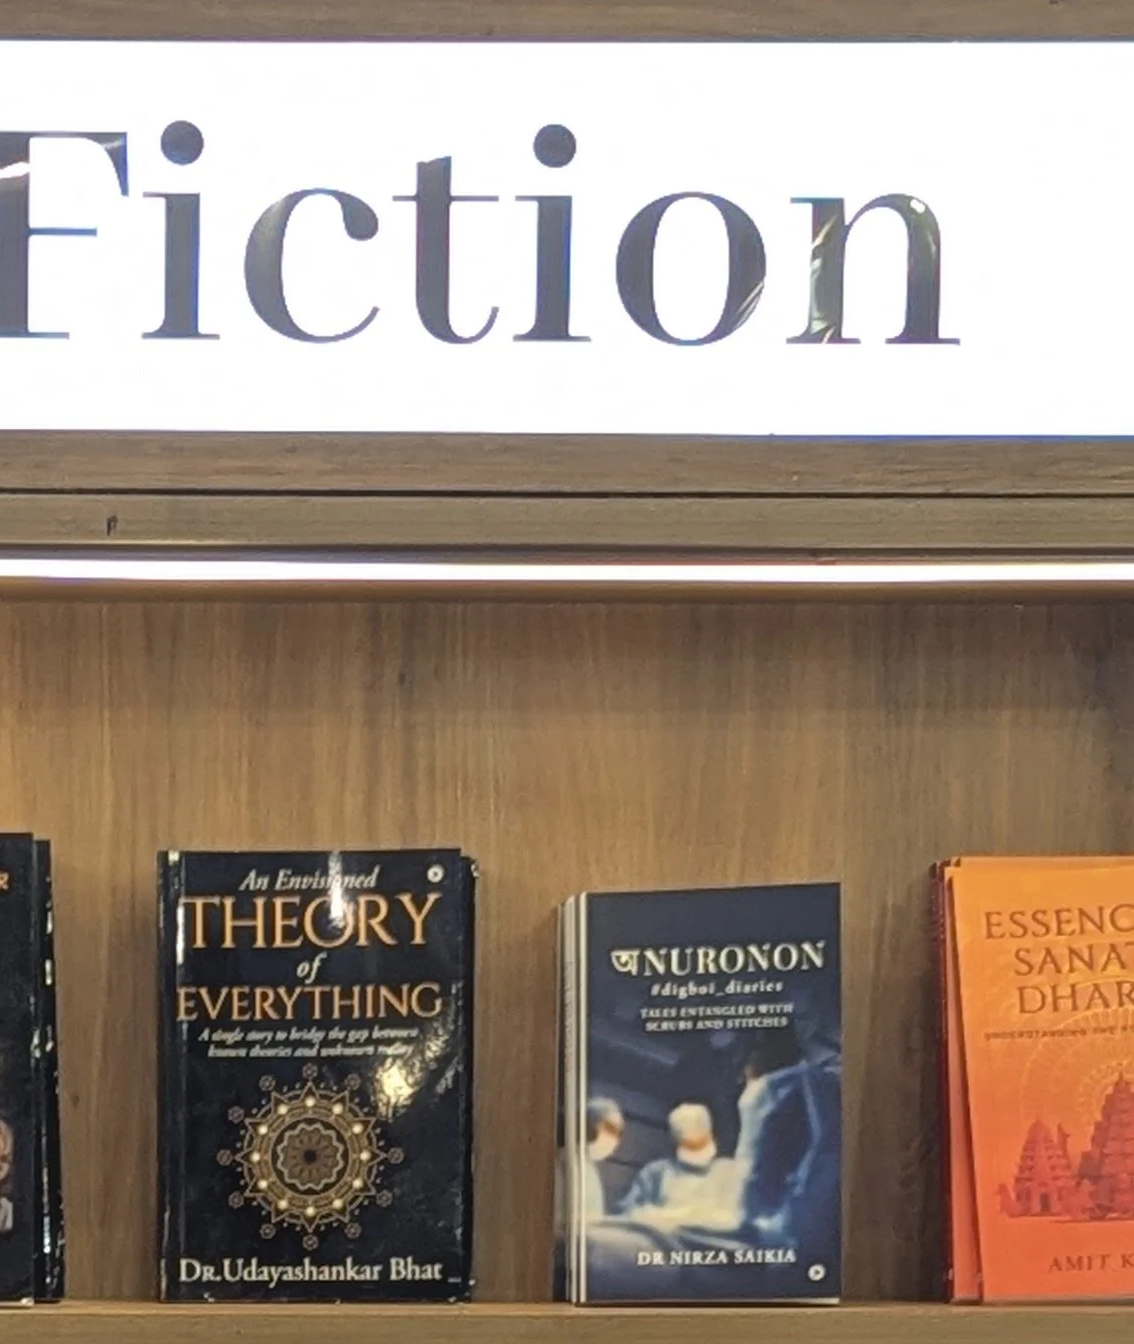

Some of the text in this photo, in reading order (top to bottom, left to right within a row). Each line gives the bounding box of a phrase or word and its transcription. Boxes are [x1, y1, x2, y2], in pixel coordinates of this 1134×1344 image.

[239, 865, 381, 891] An Envisioned
[179, 893, 443, 948] THEORY
[297, 952, 327, 984] of
[176, 982, 443, 1022] EVERYTHING
[680, 1005, 755, 1018] ENTANGLED
[758, 1003, 794, 1014] WITH
[696, 1018, 724, 1030] AND
[726, 1016, 788, 1028] STITCHES
[390, 1256, 442, 1281] Bhat
[637, 1249, 796, 1266] DR NIRZA SAIKIA
[1047, 1254, 1111, 1273] AMIT
